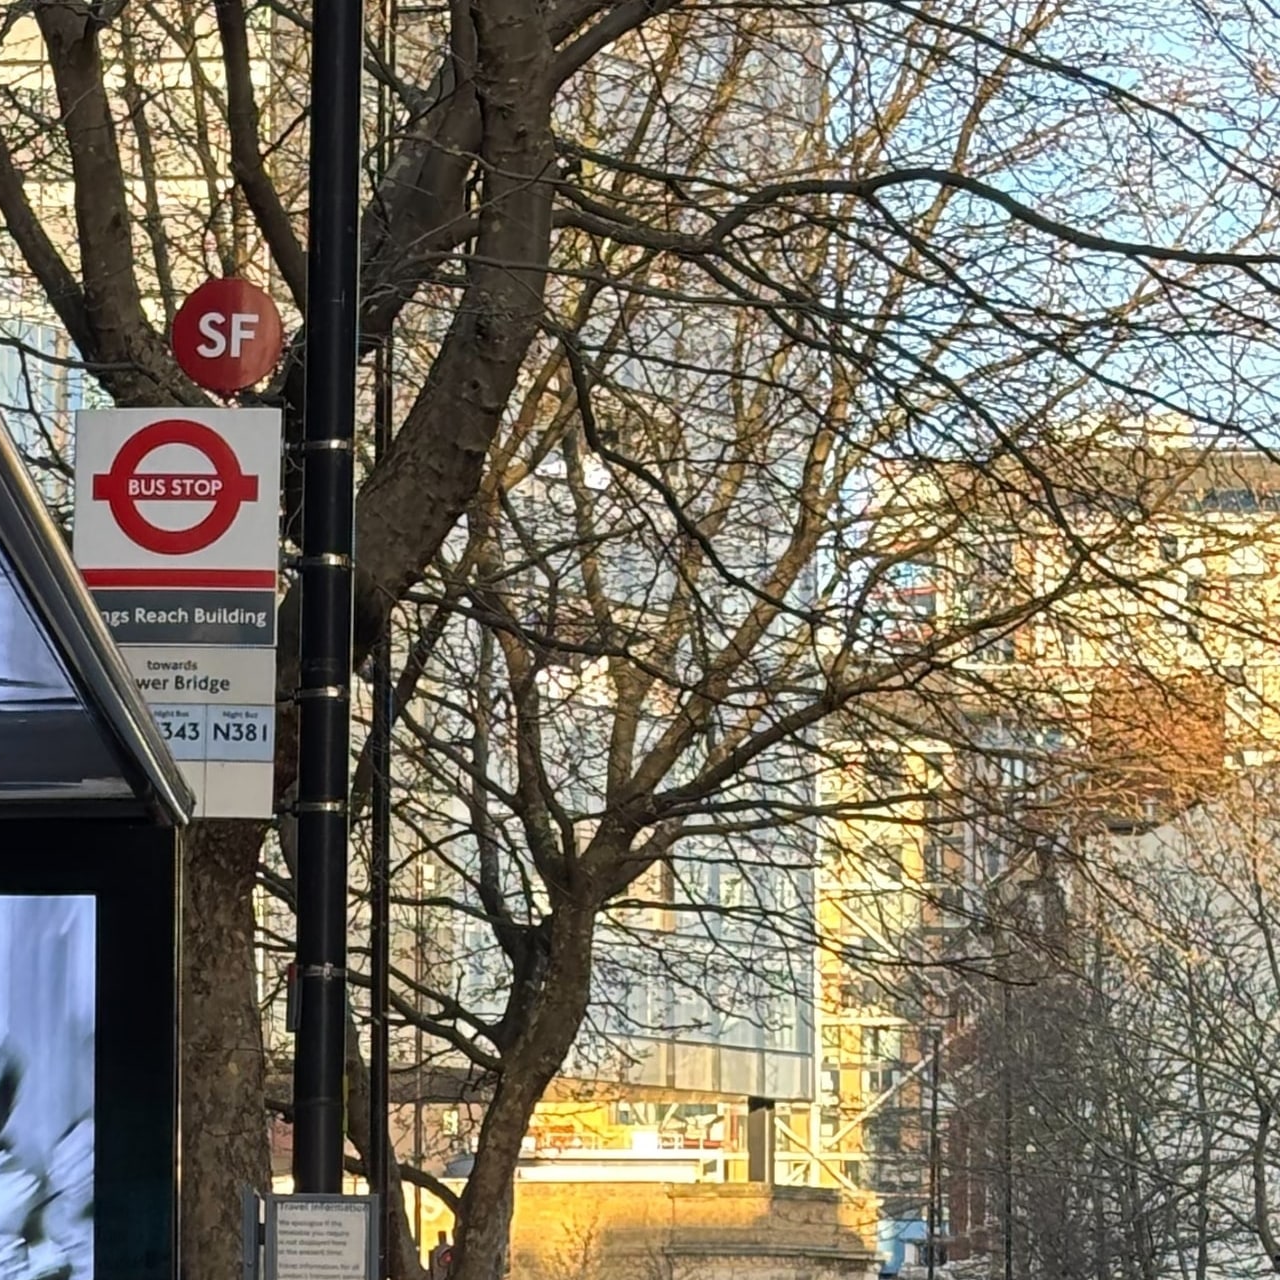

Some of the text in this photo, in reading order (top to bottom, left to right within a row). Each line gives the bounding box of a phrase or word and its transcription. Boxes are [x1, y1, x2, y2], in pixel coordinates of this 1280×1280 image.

[196, 311, 260, 360] SF
[128, 478, 223, 498] BUS STOP
[101, 607, 267, 628] ngs Reach Building
[147, 659, 198, 671] towards
[136, 675, 231, 694] wer Bridge
[157, 721, 200, 741] 343
[213, 722, 268, 742] N381
